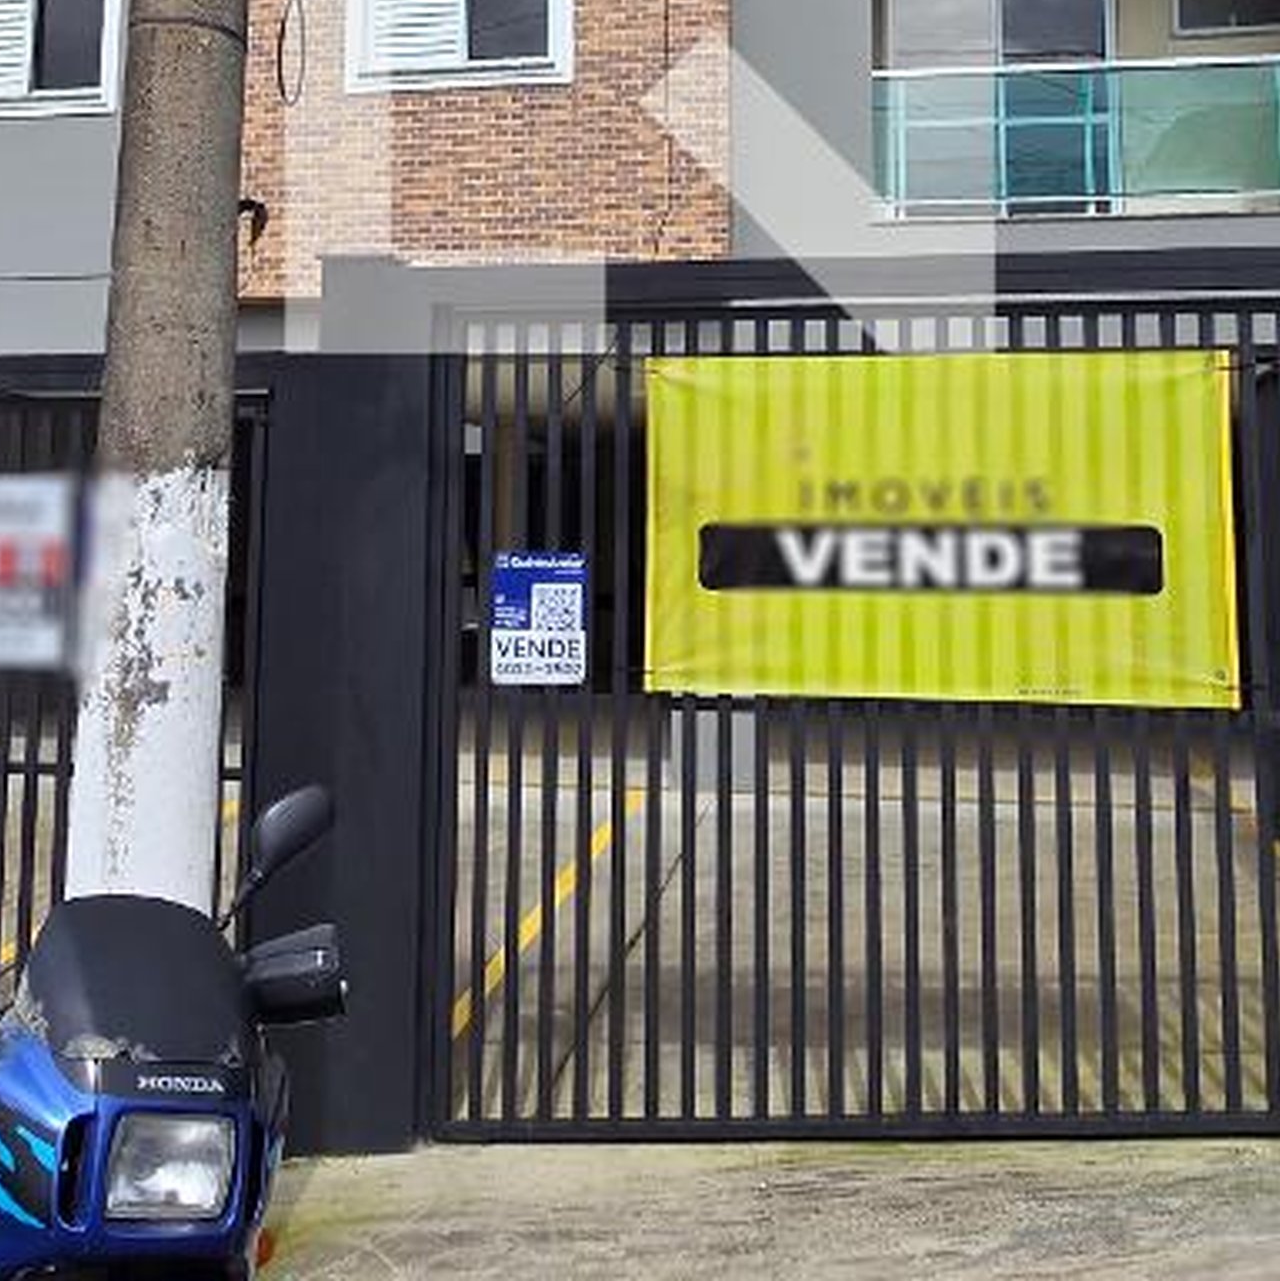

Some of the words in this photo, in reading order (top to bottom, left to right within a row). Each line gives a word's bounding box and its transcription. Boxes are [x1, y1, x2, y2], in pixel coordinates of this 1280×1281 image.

[774, 528, 1083, 587] VENDE
[494, 636, 582, 659] VENDE
[137, 1076, 225, 1092] HONDA
